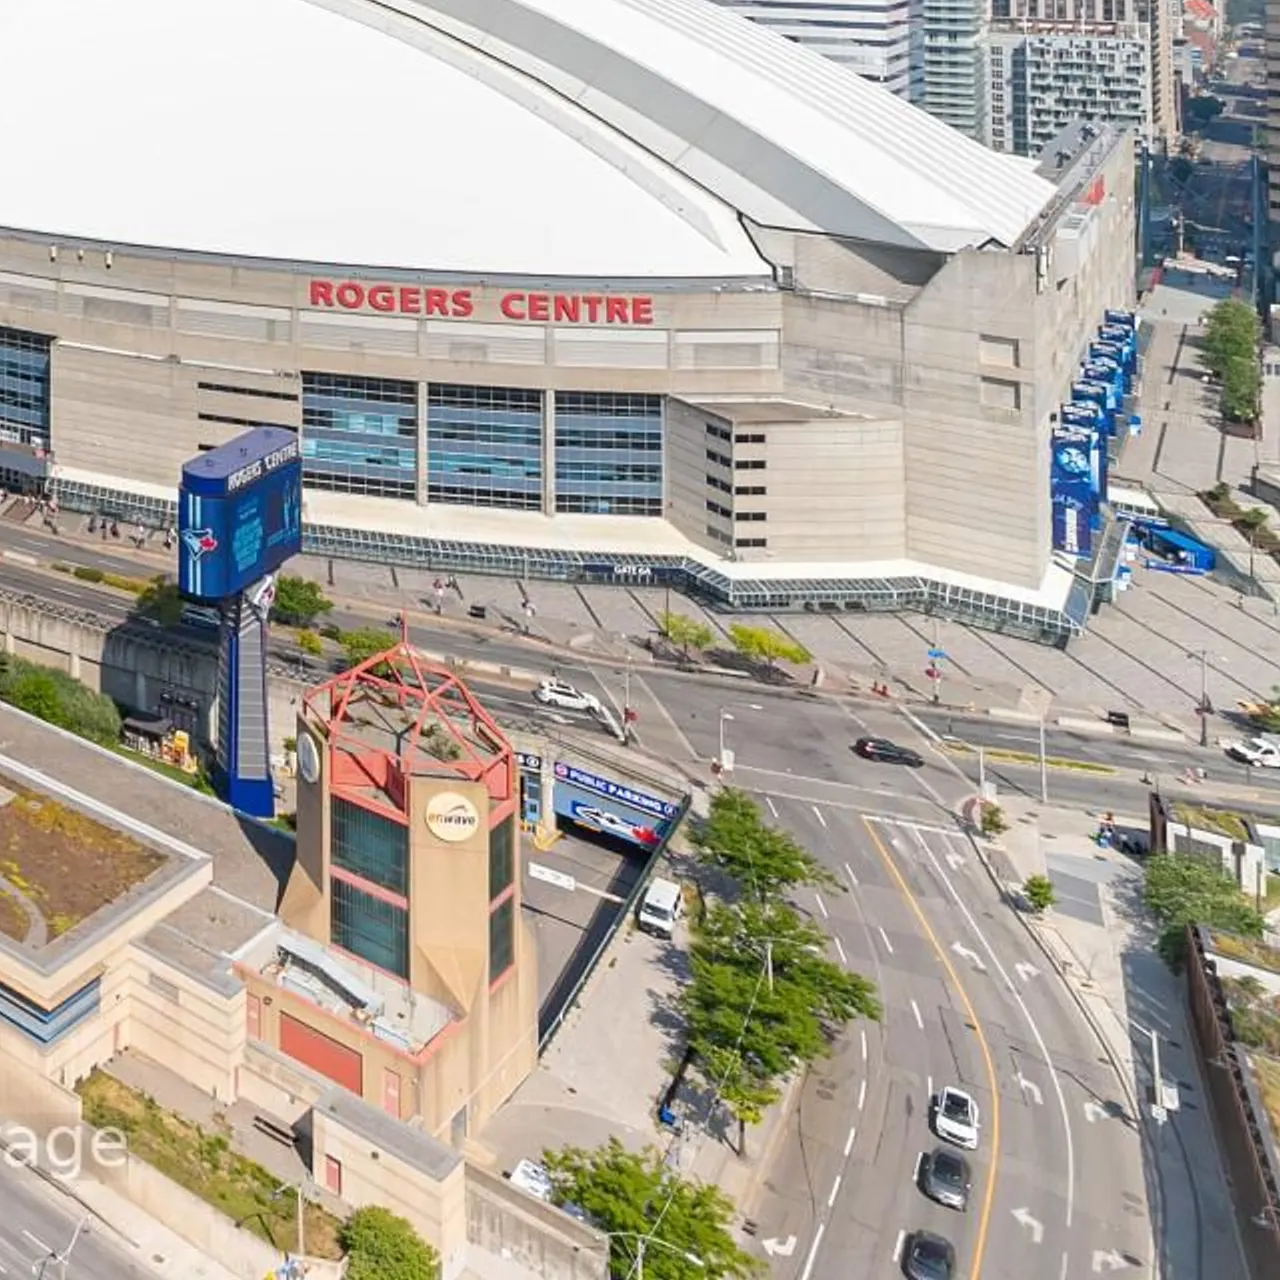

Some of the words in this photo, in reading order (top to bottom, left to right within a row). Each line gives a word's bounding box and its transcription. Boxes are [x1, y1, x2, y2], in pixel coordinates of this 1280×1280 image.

[309, 280, 474, 318] ROGERS
[500, 293, 655, 325] CENTRE
[569, 769, 608, 792] PUBLIC
[608, 783, 663, 812] PARKING
